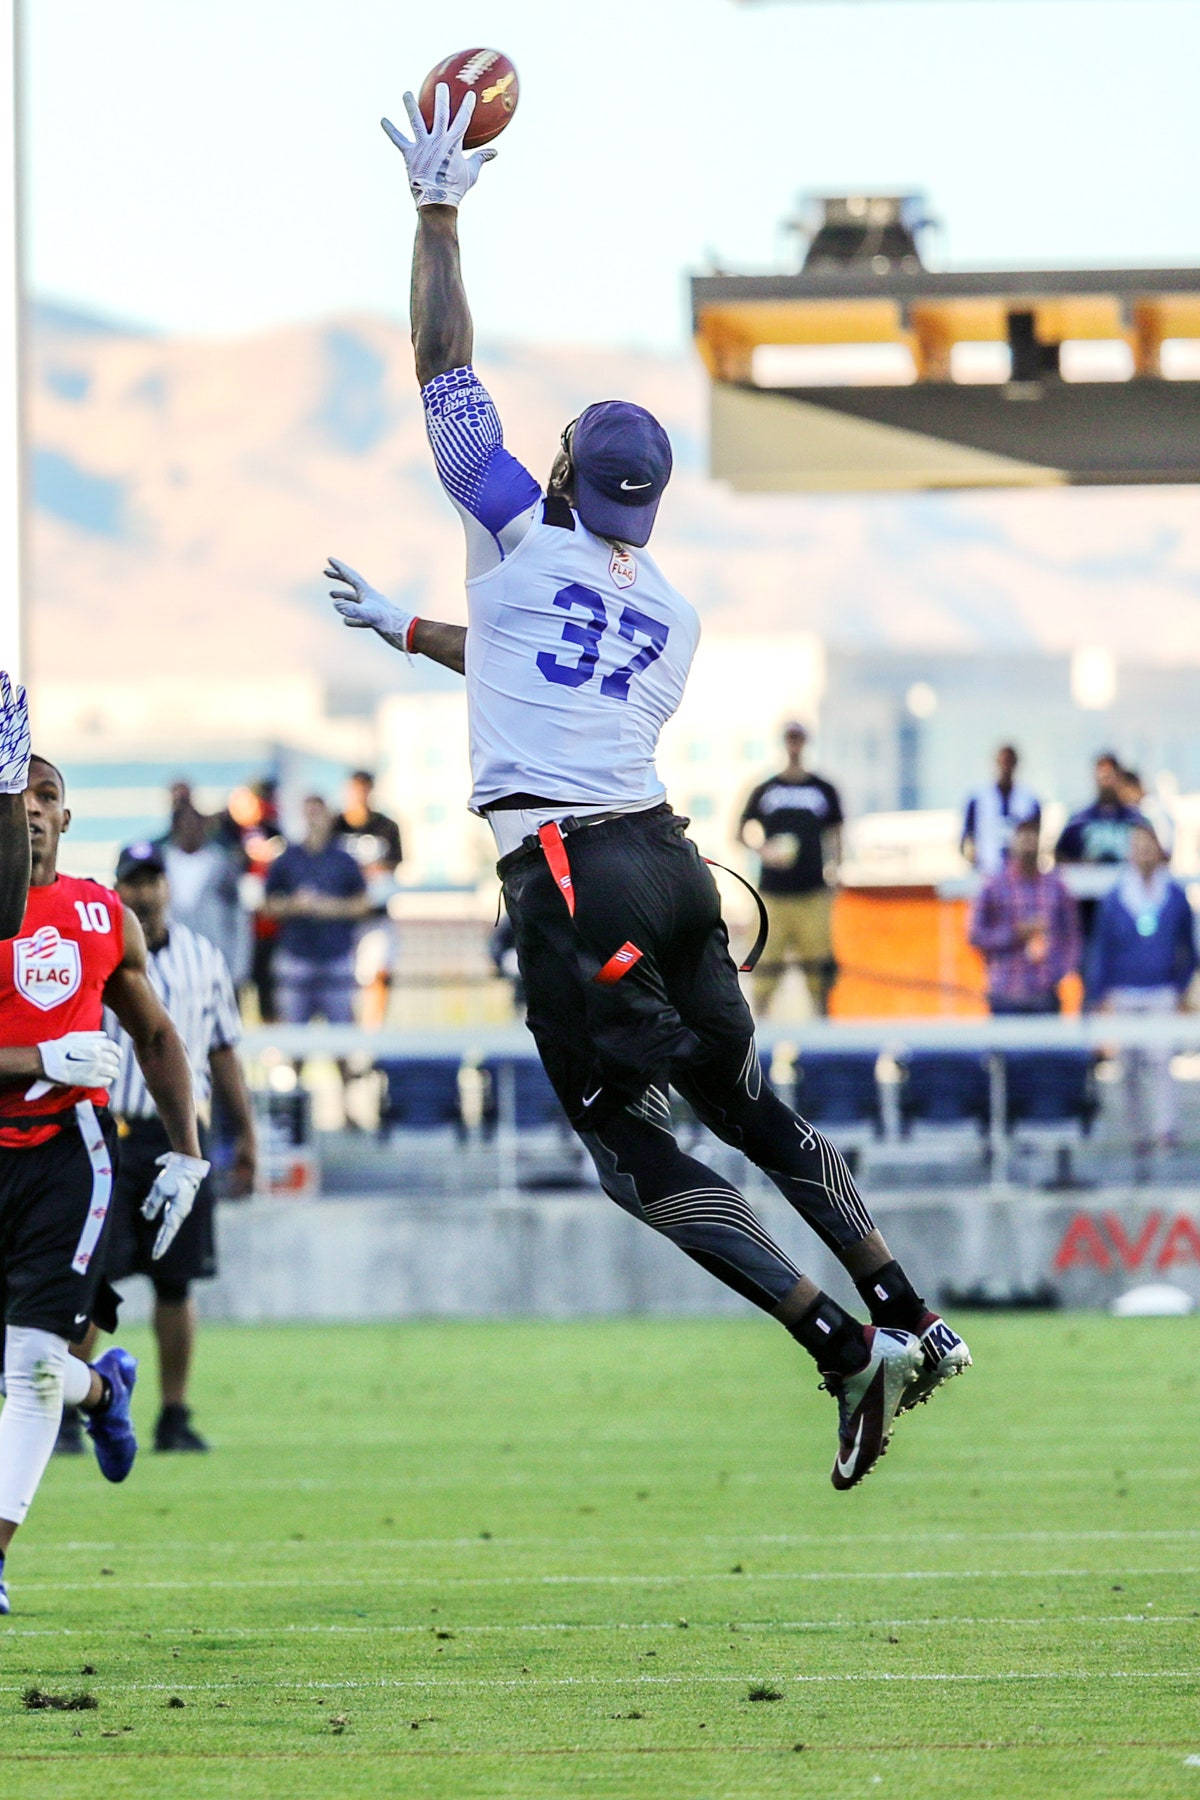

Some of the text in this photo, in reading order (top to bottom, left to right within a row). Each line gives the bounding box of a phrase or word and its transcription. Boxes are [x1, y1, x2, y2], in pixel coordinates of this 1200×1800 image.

[443, 396, 469, 416] PRO
[611, 563, 633, 581] FLAG
[536, 583, 670, 701] 37
[73, 900, 112, 934] 10
[25, 968, 70, 986] FLAG
